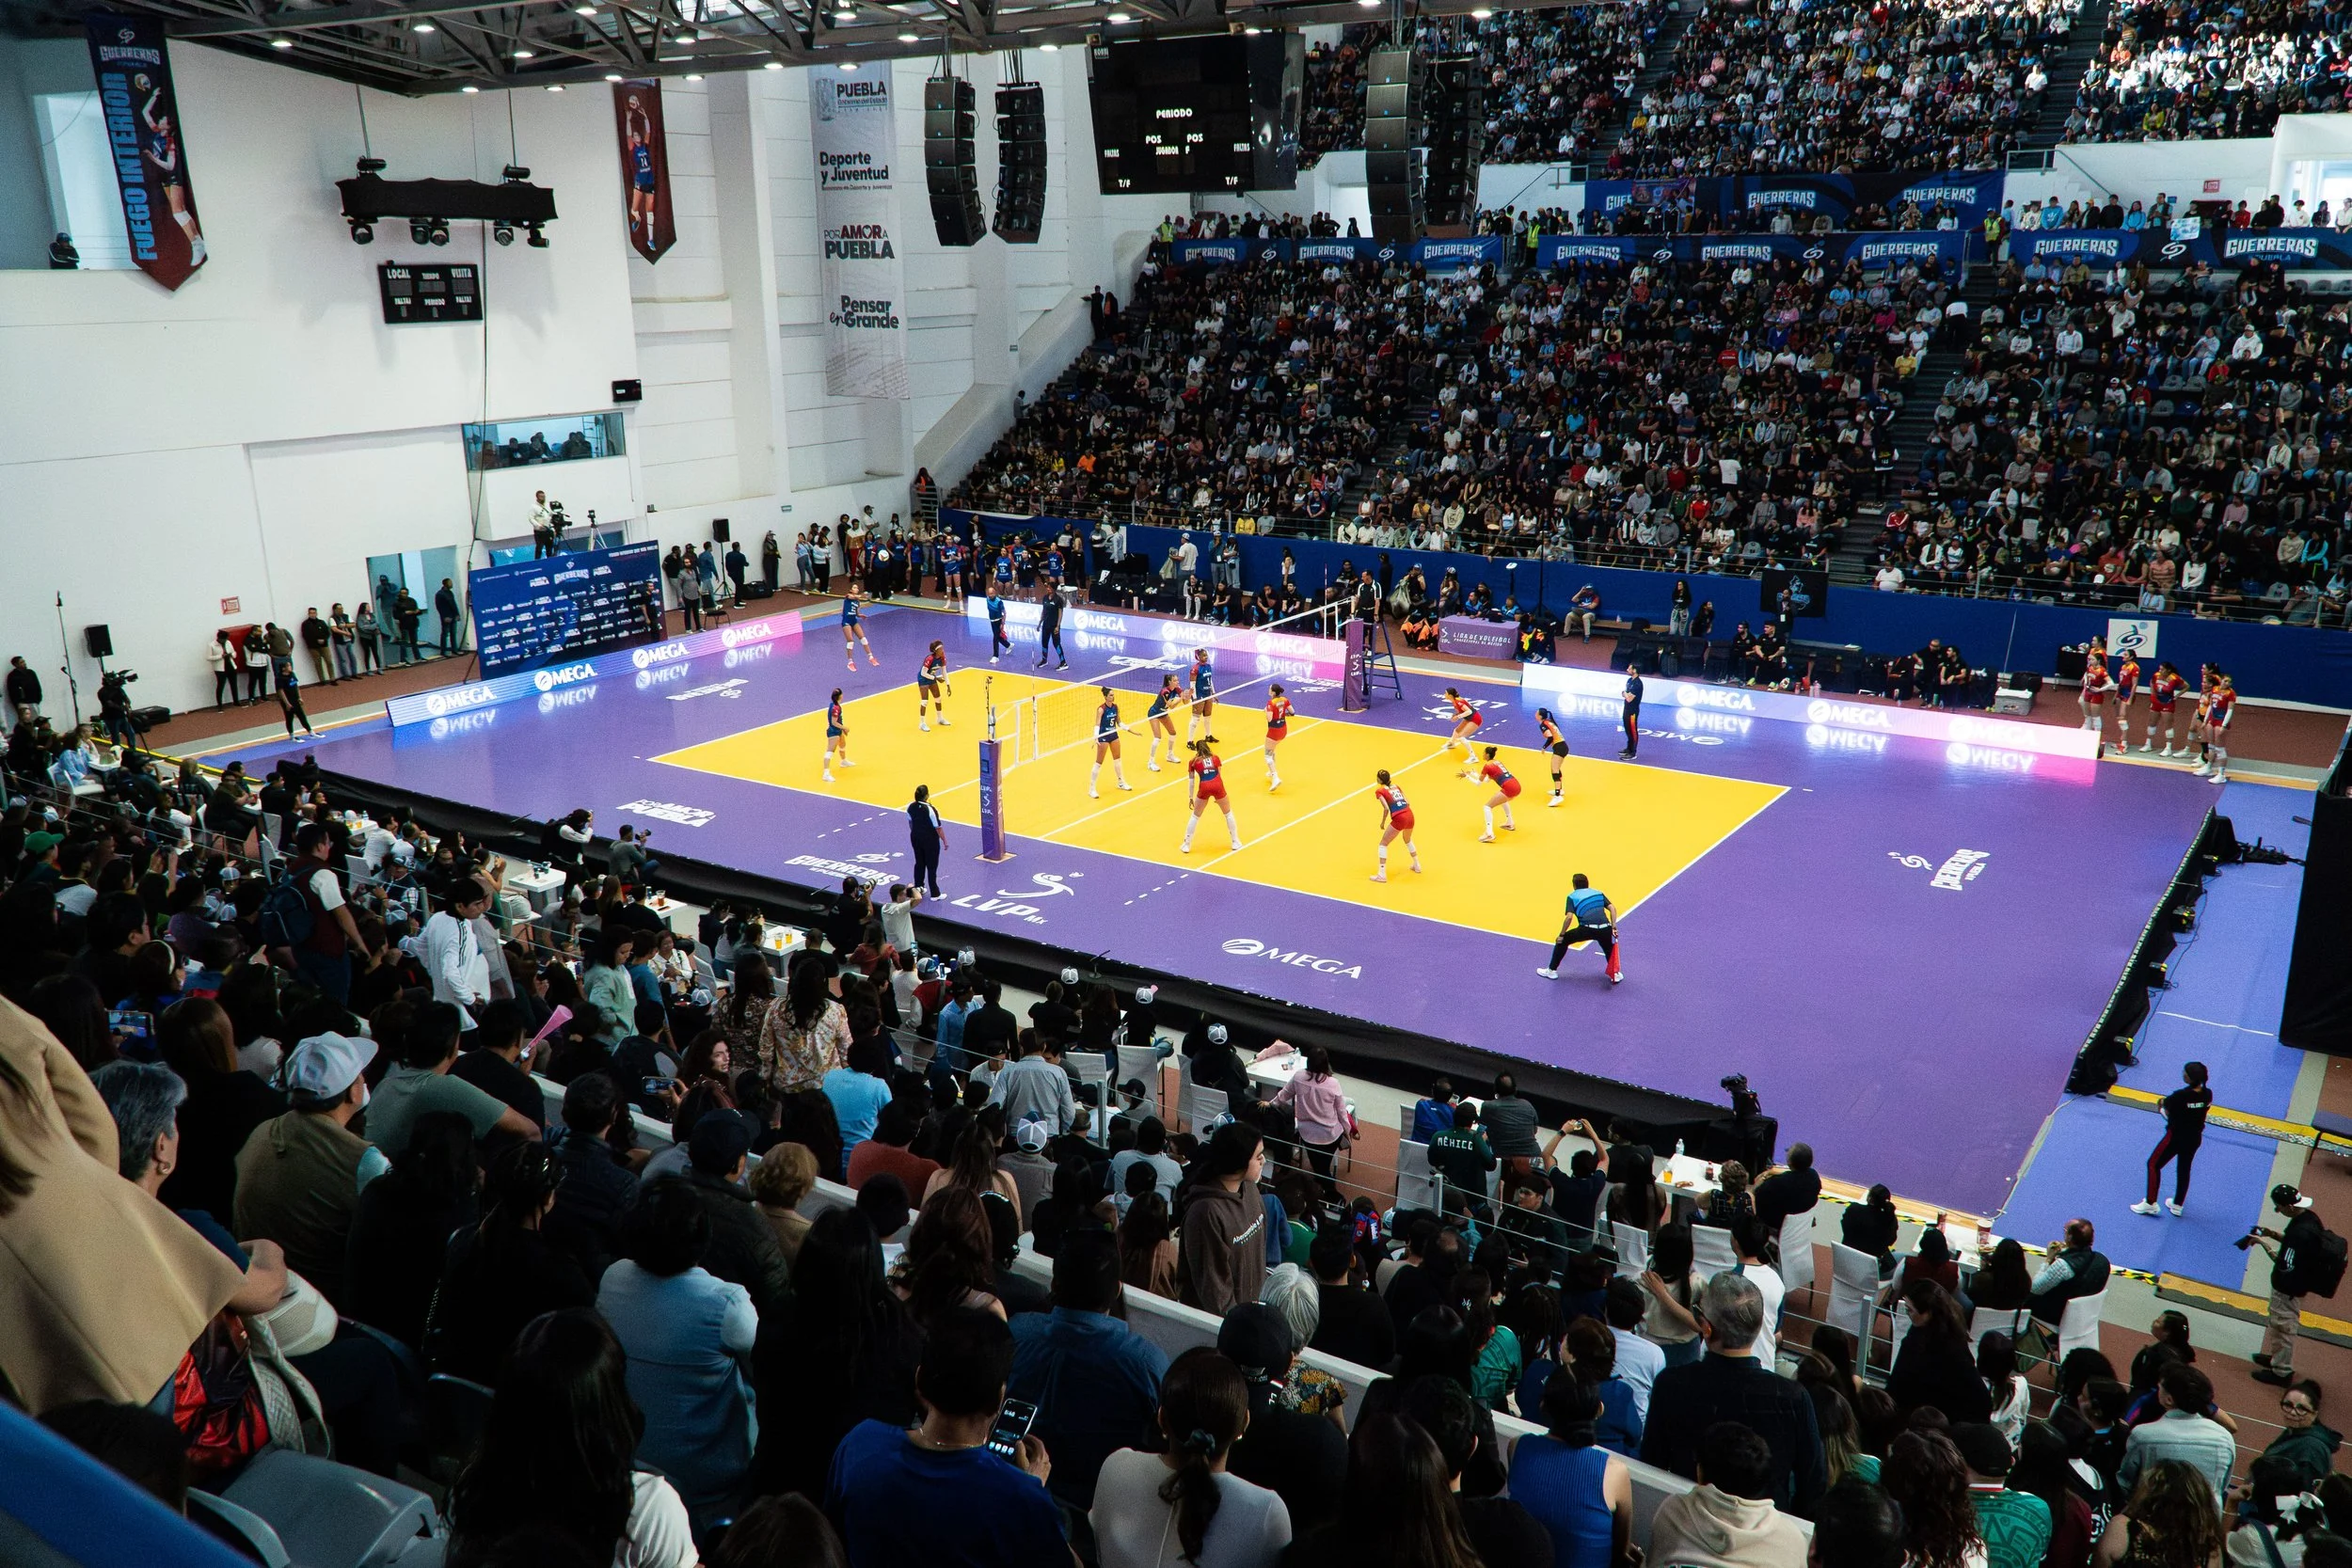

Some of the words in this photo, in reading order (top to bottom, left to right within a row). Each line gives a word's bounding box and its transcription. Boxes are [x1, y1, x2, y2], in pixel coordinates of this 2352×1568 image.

[836, 81, 887, 98] PUEBLA
[1156, 108, 1193, 119] PERIODO
[102, 72, 145, 182] INTERIOR
[1146, 135, 1162, 144] POS
[1186, 134, 1203, 143] POS
[819, 151, 871, 168] Deporte
[820, 170, 828, 184] y
[831, 165, 889, 182] Juventud
[1119, 179, 1131, 188] T/F
[1225, 176, 1238, 185] T/F
[1748, 190, 1816, 209] GUERRERAS
[1903, 187, 1977, 204] GUERRERAS
[124, 188, 158, 261] FUEGO
[841, 225, 882, 239] AMOR
[824, 240, 895, 260] PUEBLA
[1299, 245, 1355, 261] GUERRERAS
[1424, 245, 1484, 260] GUERRERAS
[1557, 245, 1620, 261] GUERRERAS
[1702, 245, 1772, 261] GUERRERAS
[1862, 243, 1940, 261] GUERRERAS
[2035, 239, 2119, 257] GUERRERAS
[2224, 237, 2318, 259] GUERRERAS
[387, 269, 411, 278] LOCAL
[452, 268, 472, 278] VISITA
[841, 295, 892, 312] Pensar
[845, 311, 899, 329] Grande
[1087, 612, 1126, 631] MEGA
[736, 623, 773, 641] MEGA
[1177, 625, 1216, 641] MEGA
[649, 642, 690, 663] MEGA
[552, 663, 597, 686] MEGA
[446, 686, 497, 707] MEGA
[1695, 688, 1755, 710] MEGA
[1830, 707, 1892, 728] MEGA
[784, 854, 900, 885] GUERRERAS
[950, 894, 1041, 916] LVP
[1257, 947, 1362, 979] MEGA
